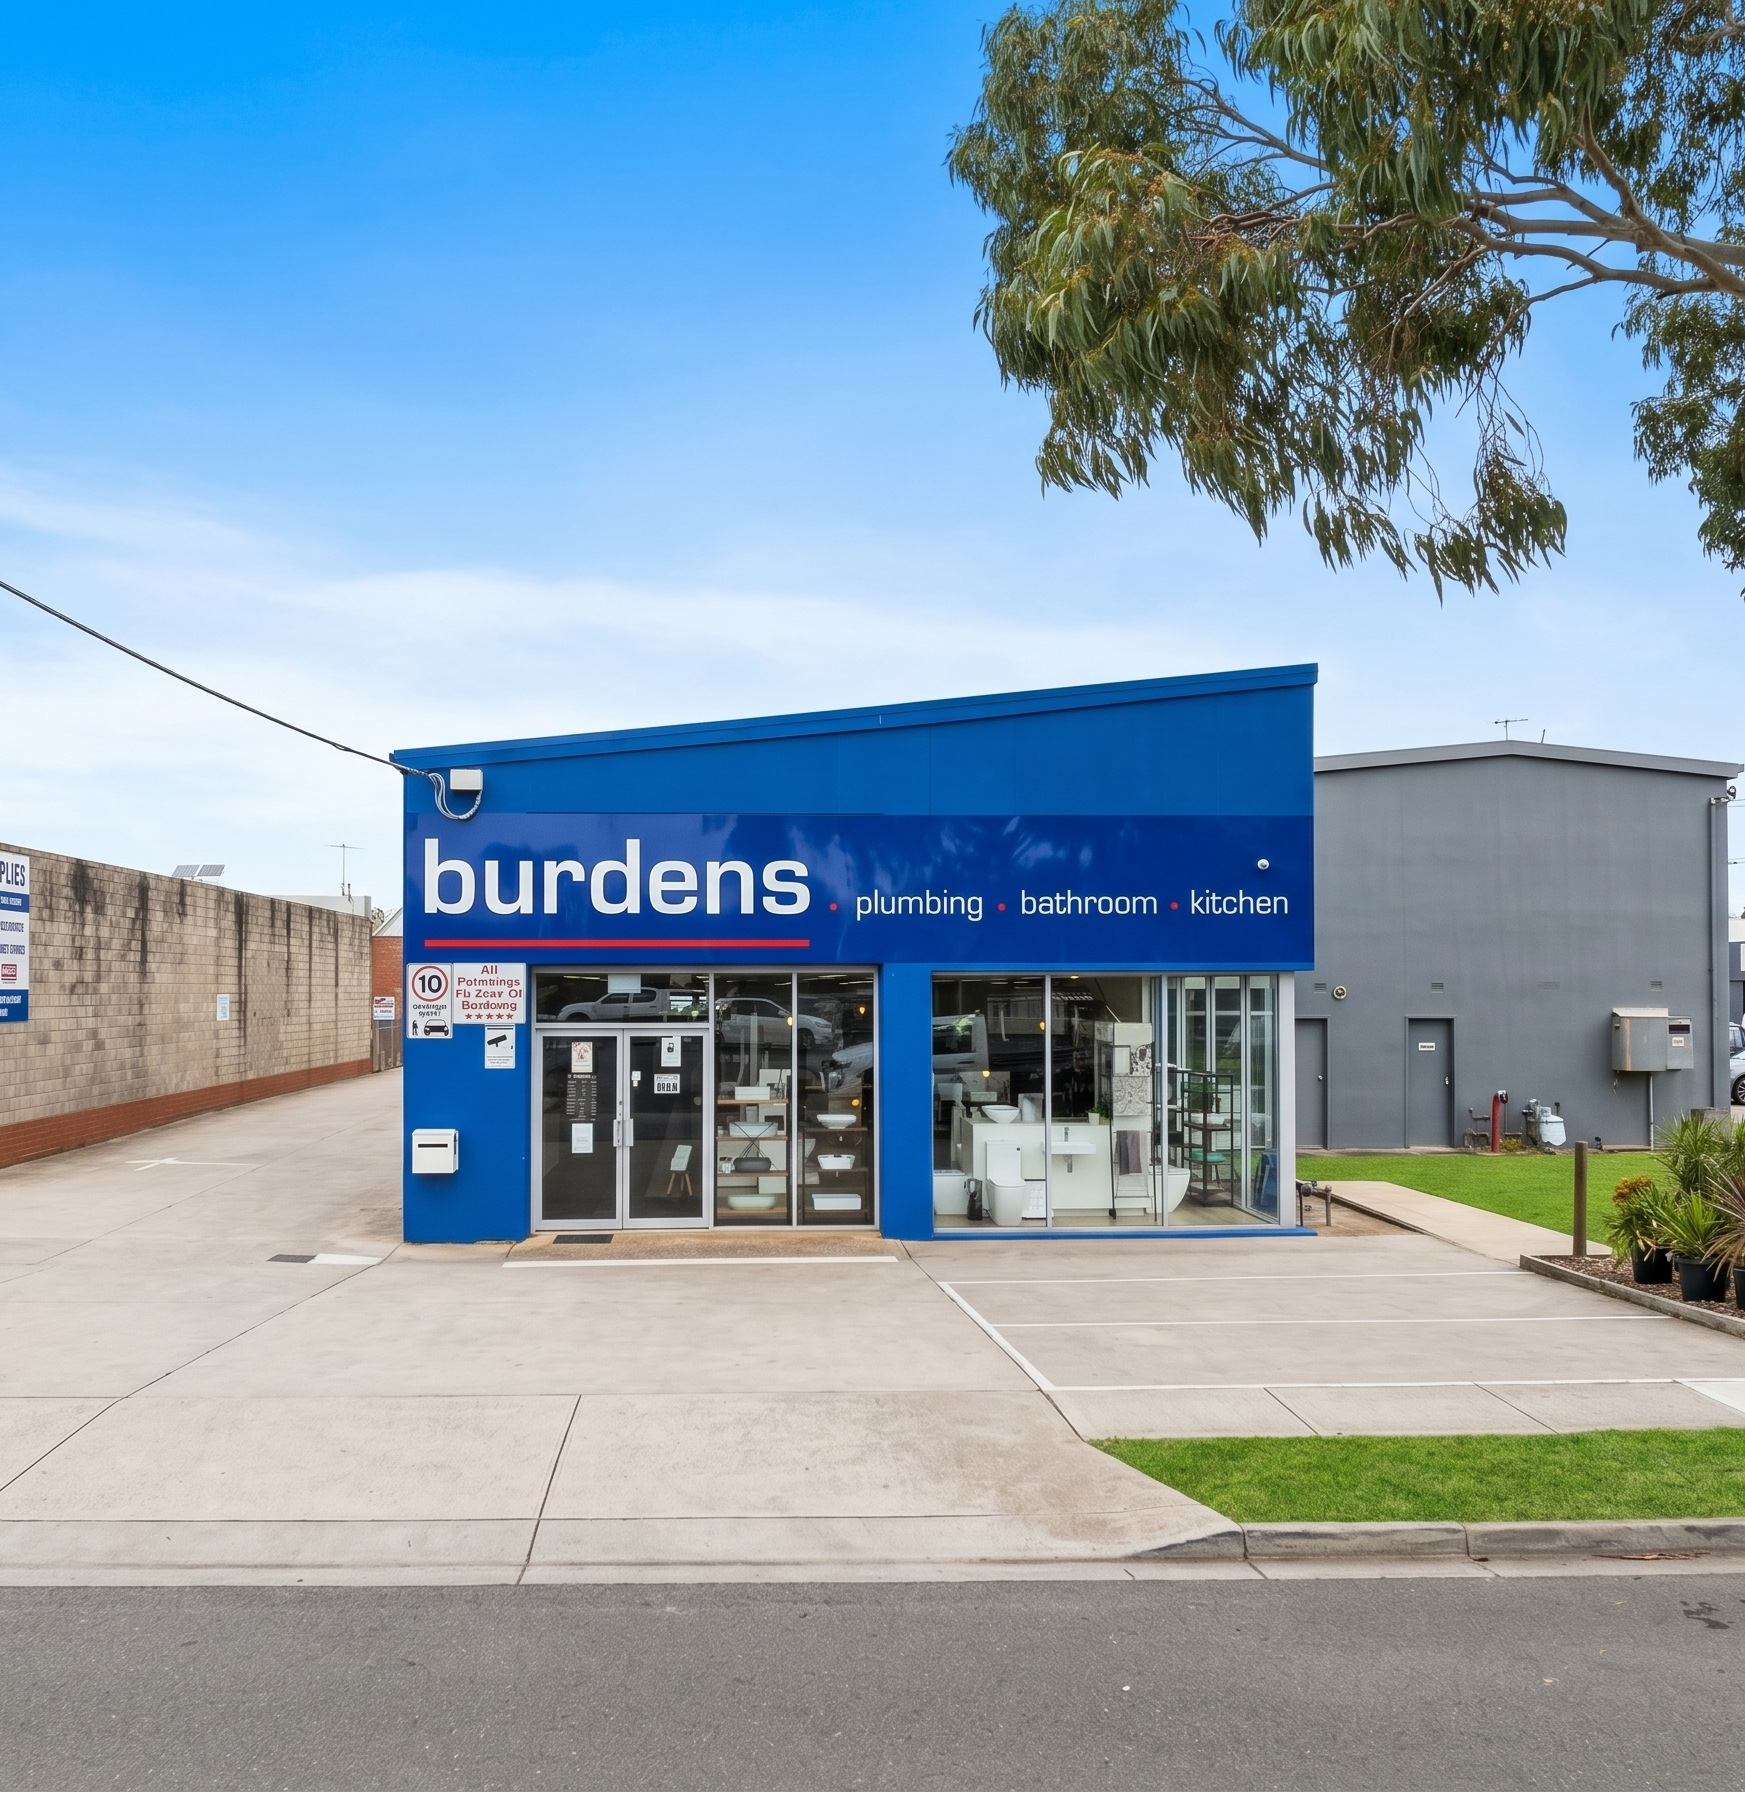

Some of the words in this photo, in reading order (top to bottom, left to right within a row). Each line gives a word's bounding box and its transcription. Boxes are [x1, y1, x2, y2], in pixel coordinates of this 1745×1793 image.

[0, 860, 26, 887] PLIES
[423, 838, 812, 916] burdens
[855, 889, 983, 922] plumbing
[1020, 889, 1158, 915] bathroom
[1189, 889, 1289, 915] kitchen
[480, 965, 498, 975] All
[418, 974, 443, 994] 10
